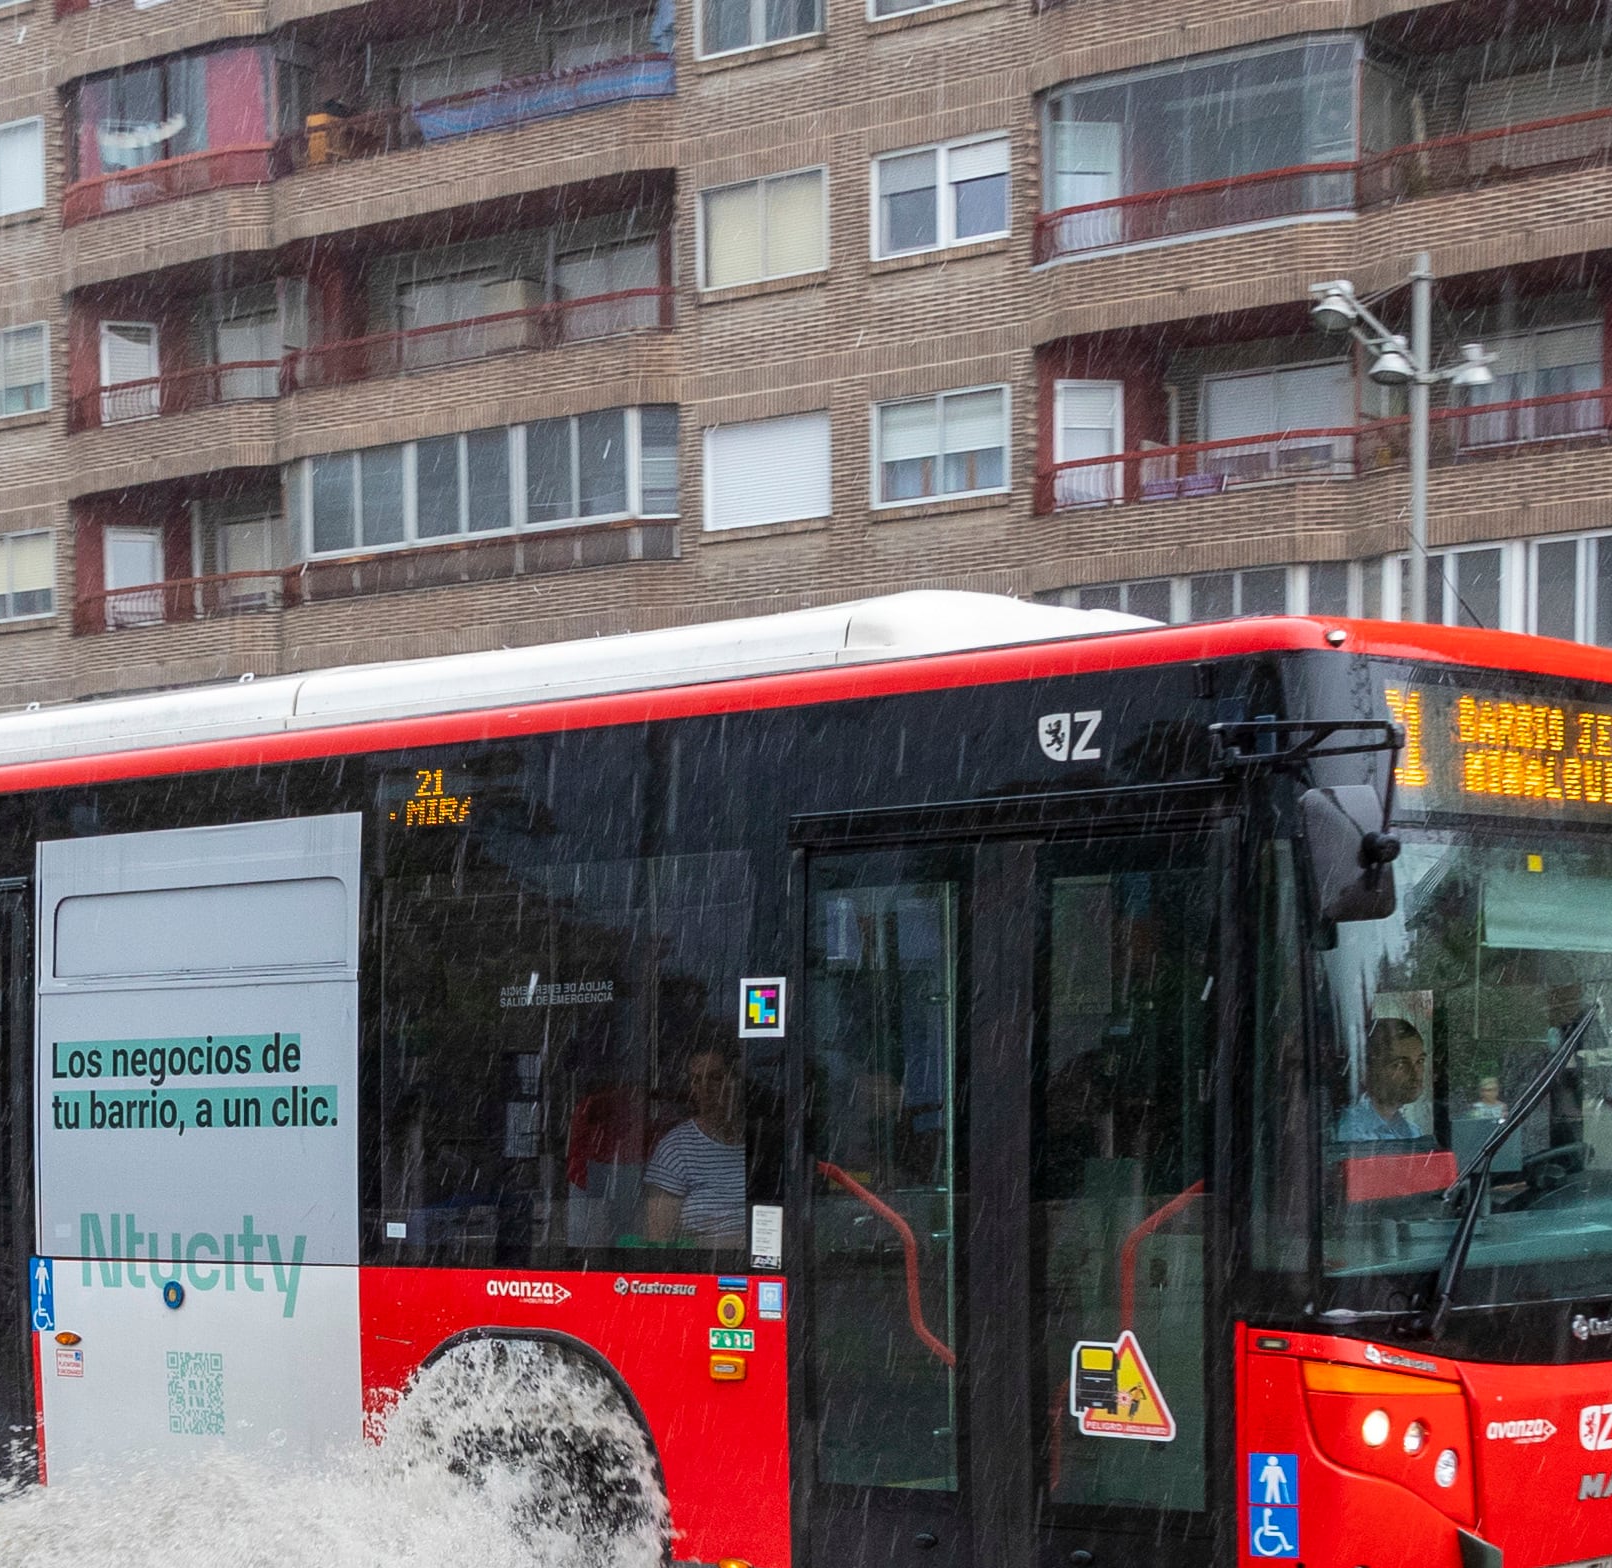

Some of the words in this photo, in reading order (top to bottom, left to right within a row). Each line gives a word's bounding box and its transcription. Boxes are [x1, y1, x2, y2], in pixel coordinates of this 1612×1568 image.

[1458, 695, 1565, 752] BARRIO
[415, 769, 444, 797] 21
[536, 995, 548, 1006] DE
[549, 991, 614, 1006] EMERGENCIA
[52, 1042, 103, 1079] Los
[112, 1035, 252, 1087] negocios
[262, 1032, 301, 1073] de
[52, 1095, 80, 1130] tu
[90, 1090, 185, 1136] barrio,
[195, 1097, 213, 1128] a
[223, 1097, 261, 1128] un
[272, 1086, 338, 1127] clic.
[80, 1212, 307, 1319] Ntucity
[486, 1279, 554, 1298] avanza
[630, 1279, 697, 1296] Castrosua
[1486, 1418, 1544, 1440] avanza
